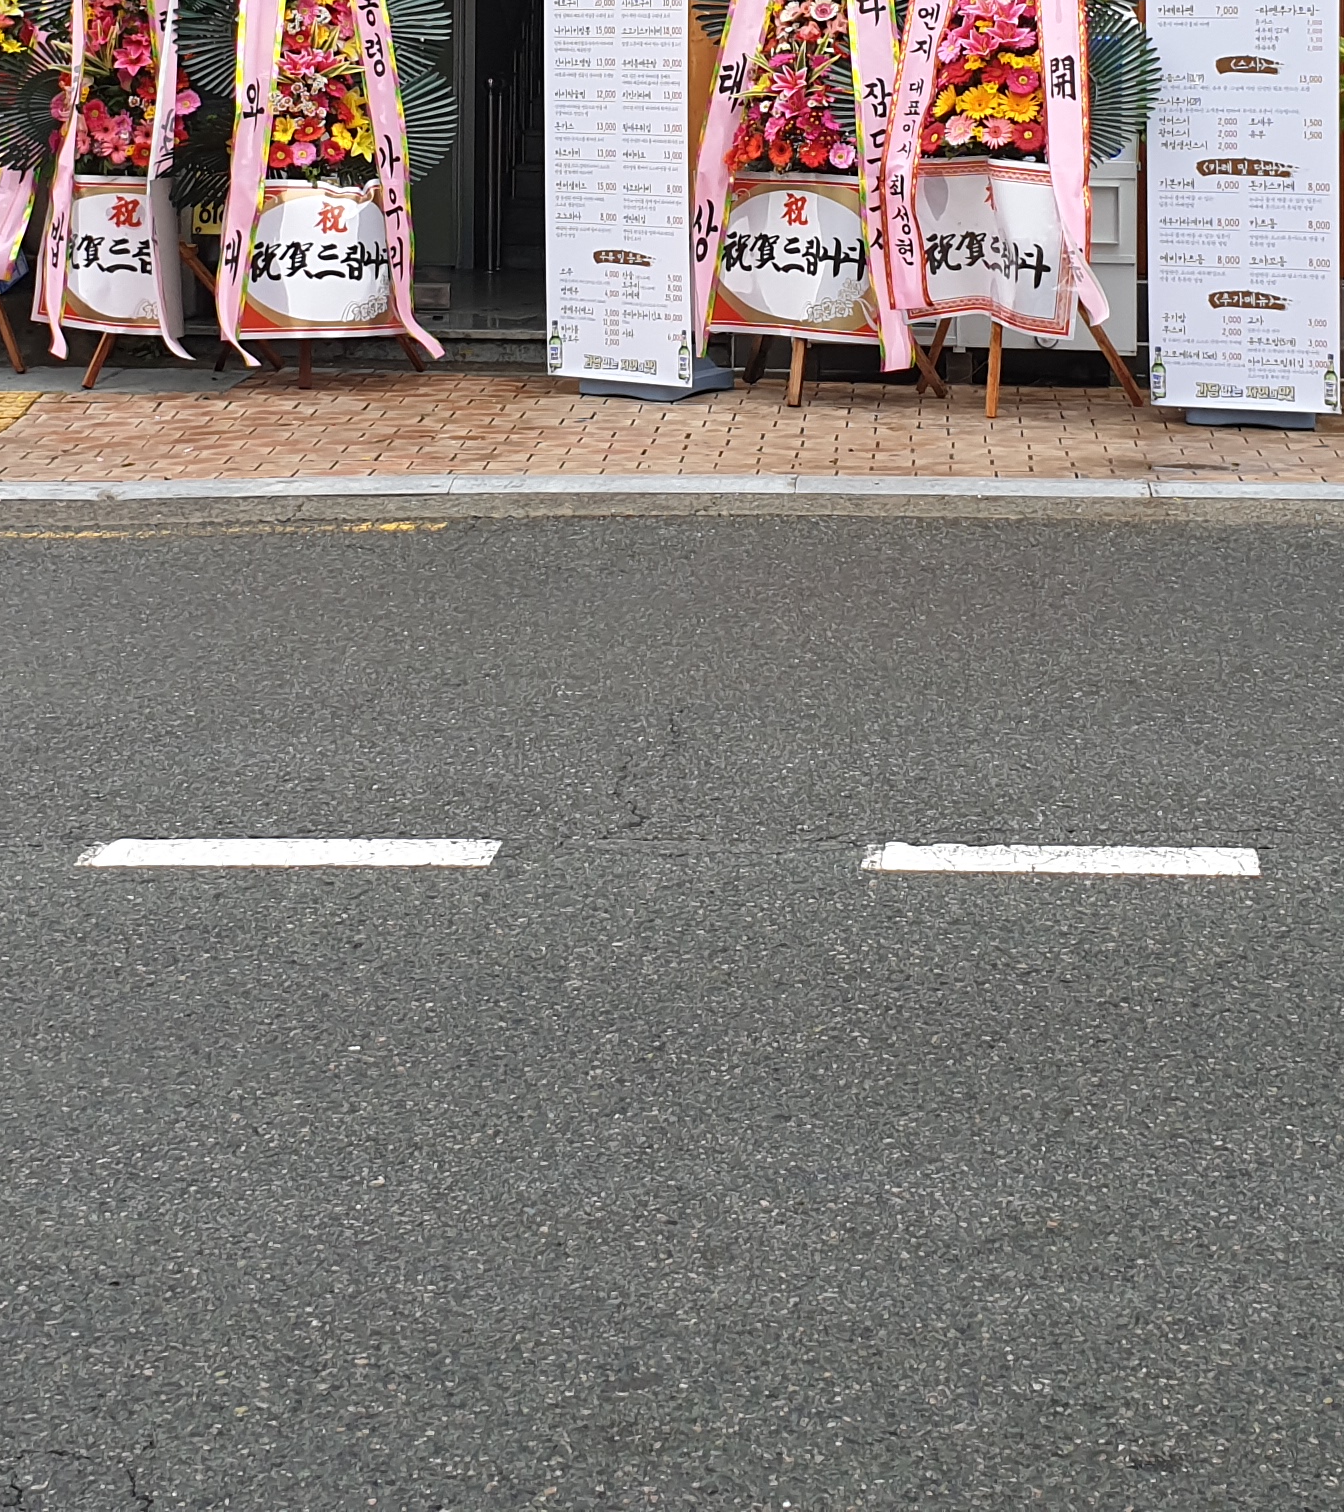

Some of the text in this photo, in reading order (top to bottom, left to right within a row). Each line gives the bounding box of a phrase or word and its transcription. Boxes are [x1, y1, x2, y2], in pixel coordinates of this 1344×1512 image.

[1215, 5, 1239, 17] 7,000
[897, 78, 924, 160] 대표이사
[1217, 117, 1238, 128] 2,000
[1303, 117, 1323, 128] 1,500
[1217, 129, 1238, 141] 2,000
[1303, 130, 1323, 141] 1,500
[1217, 141, 1238, 153] 2,000
[1216, 179, 1240, 192] 6,000
[1307, 181, 1331, 194] 8,000
[108, 195, 143, 229] 祝
[375, 134, 405, 284] 가우리
[781, 192, 810, 227] 祝
[313, 201, 348, 236] 祝
[889, 174, 915, 266] 최성현
[1216, 217, 1240, 230] 8,000
[1307, 219, 1331, 232] 8,000
[1217, 255, 1241, 267] 8,000
[1308, 257, 1331, 270] 8,000
[1221, 315, 1242, 326] 1,000
[1221, 327, 1242, 338] 2,000
[1307, 339, 1328, 350] 3,000
